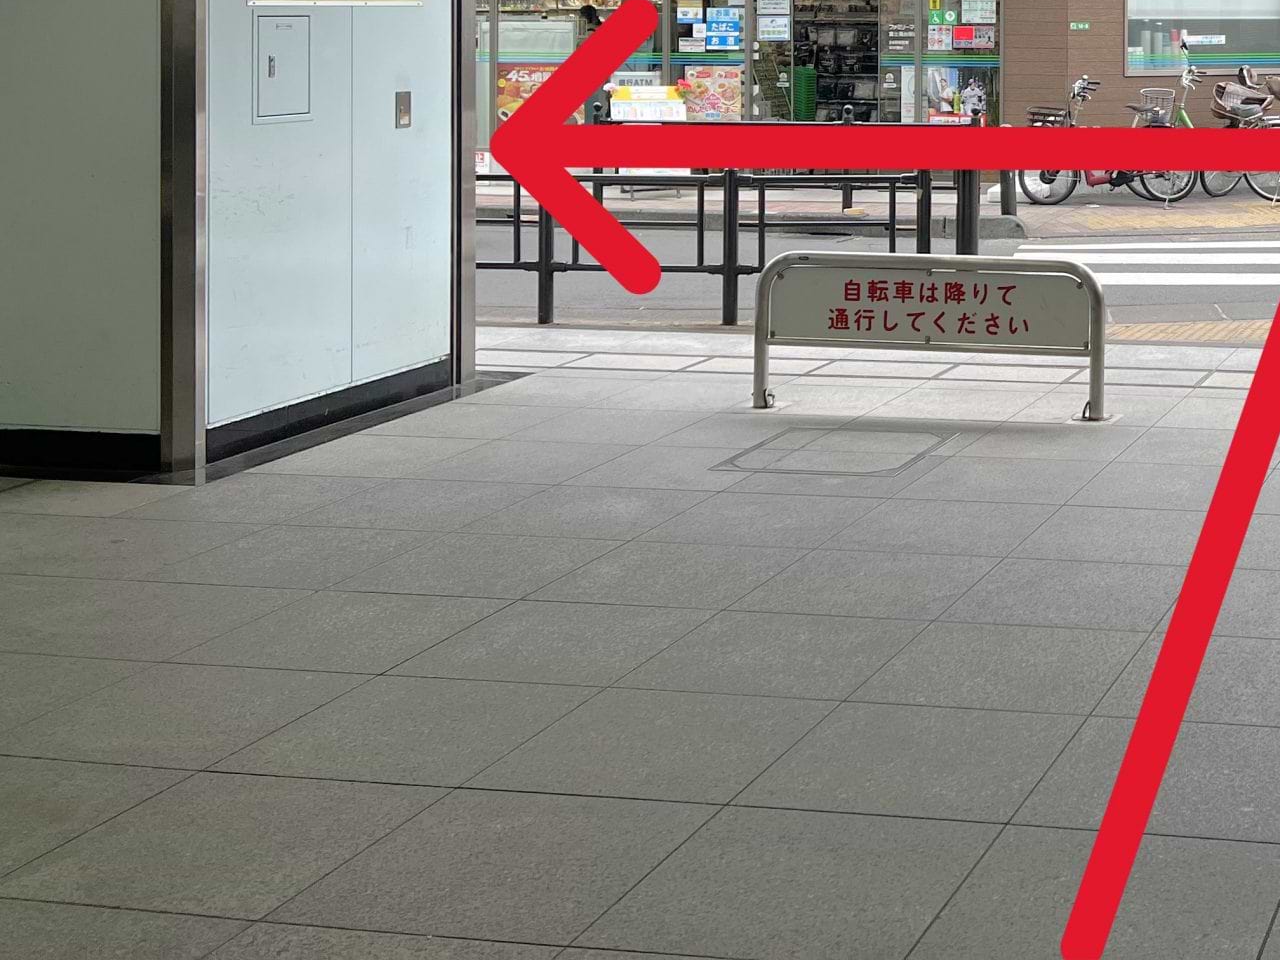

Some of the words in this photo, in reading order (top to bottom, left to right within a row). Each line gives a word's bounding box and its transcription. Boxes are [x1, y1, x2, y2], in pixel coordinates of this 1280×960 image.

[710, 22, 735, 32] たばこ
[844, 280, 1017, 305] 自転車は降りて
[828, 308, 1030, 336] 通行してください
